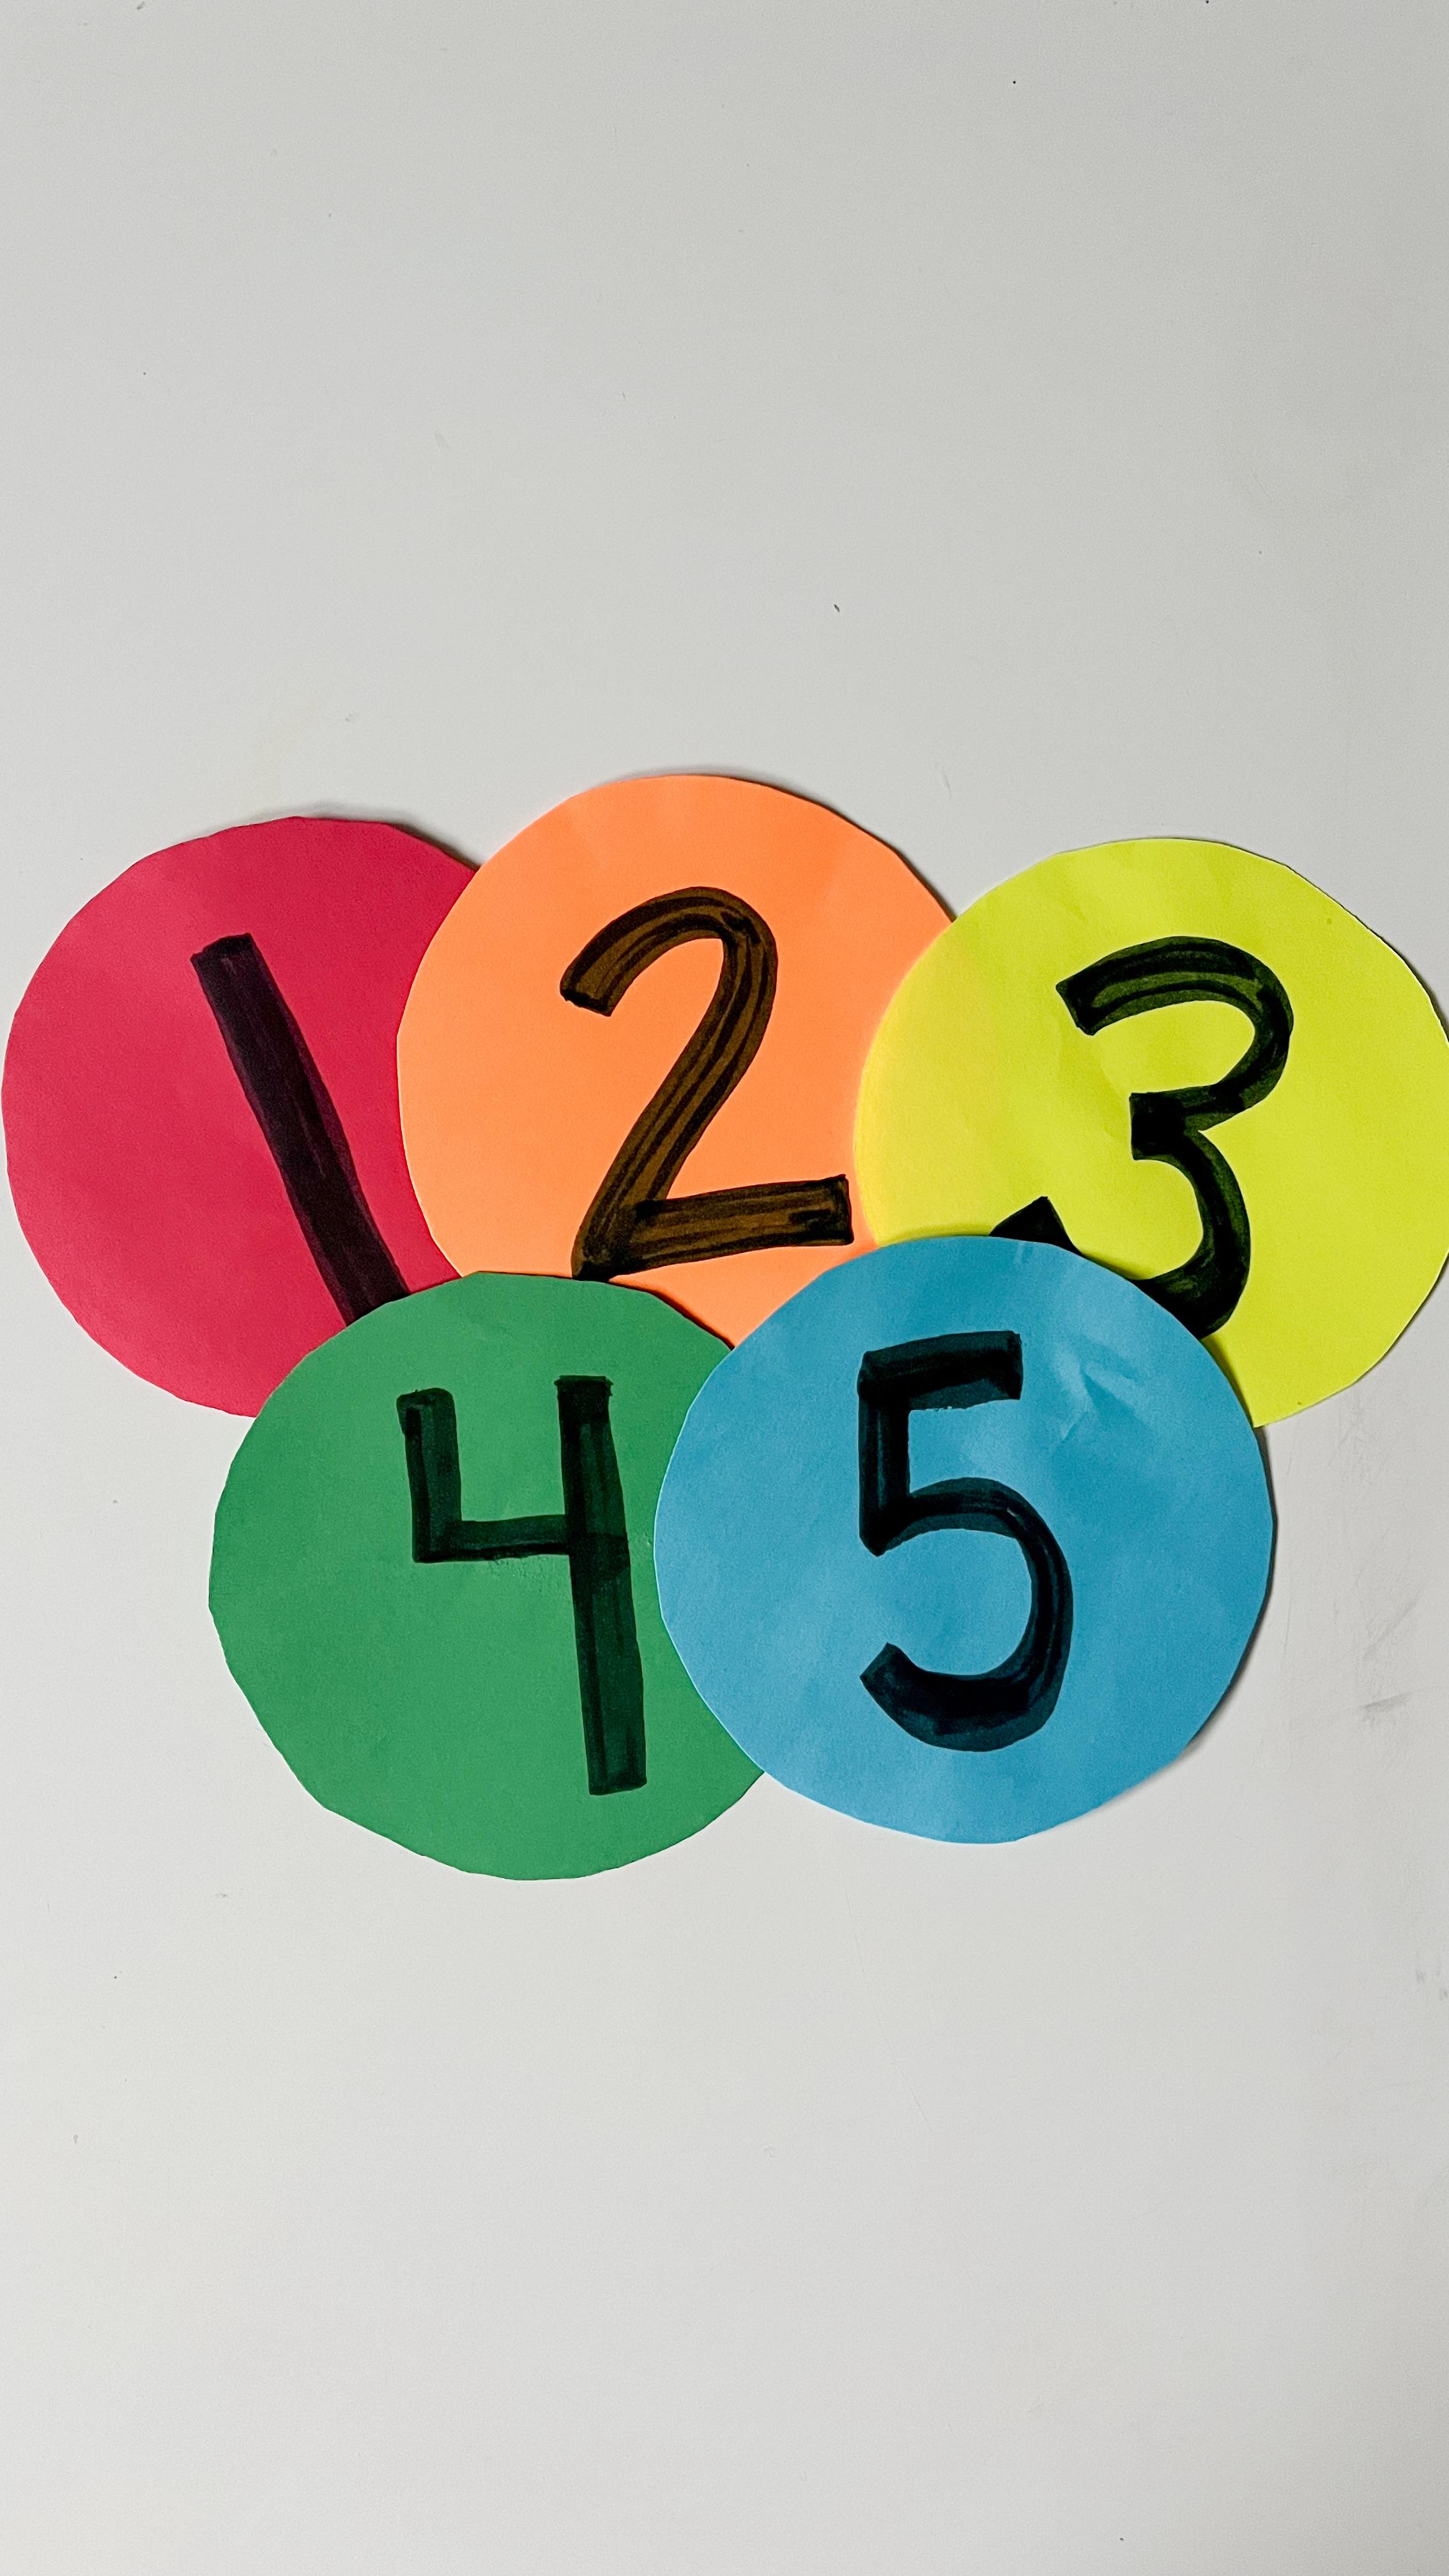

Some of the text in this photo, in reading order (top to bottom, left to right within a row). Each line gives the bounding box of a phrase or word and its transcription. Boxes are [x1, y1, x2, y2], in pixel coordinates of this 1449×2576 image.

[192, 934, 408, 1326] 1
[562, 889, 853, 1278] 2
[992, 937, 1294, 1338] 3
[397, 1376, 647, 1795] 4
[859, 1331, 1073, 1752] 5
